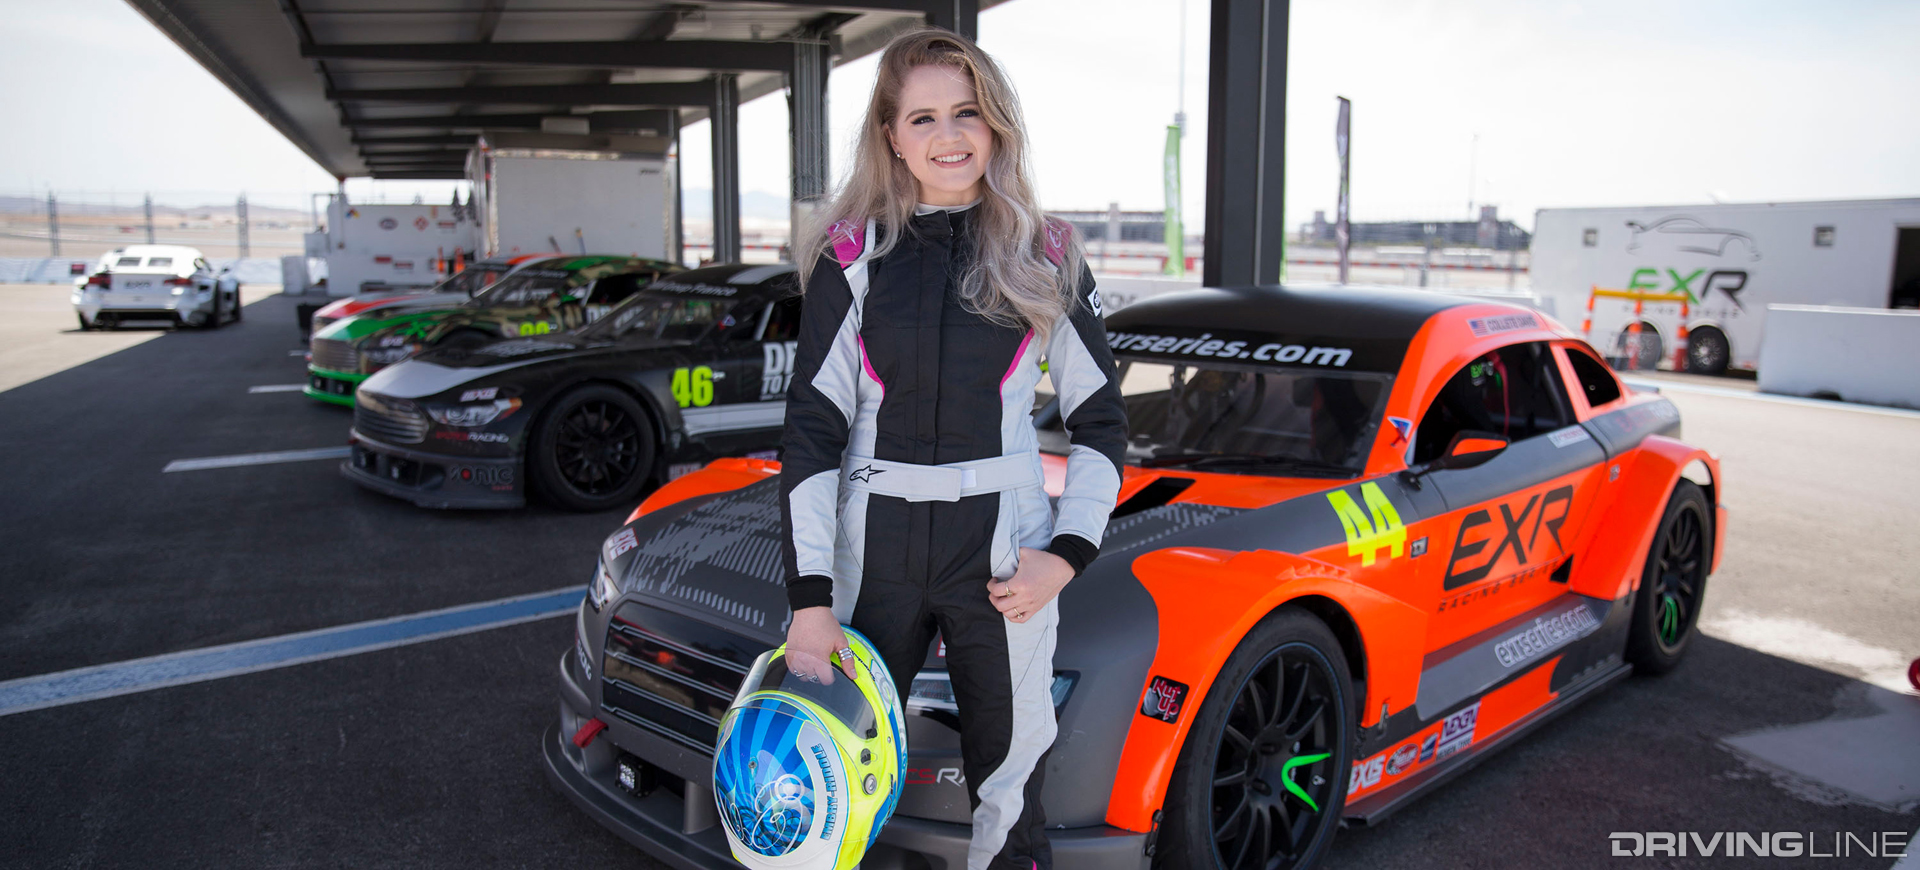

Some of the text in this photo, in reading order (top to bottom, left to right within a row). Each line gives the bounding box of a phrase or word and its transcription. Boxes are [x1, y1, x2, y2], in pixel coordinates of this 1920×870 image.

[671, 365, 714, 408] 46
[1326, 481, 1407, 568] 44
[1443, 484, 1574, 592] EXR
[1437, 583, 1501, 614] RACING
[1494, 604, 1598, 668] exrseries.com
[811, 743, 838, 841] EMBRY-RIDDLE
